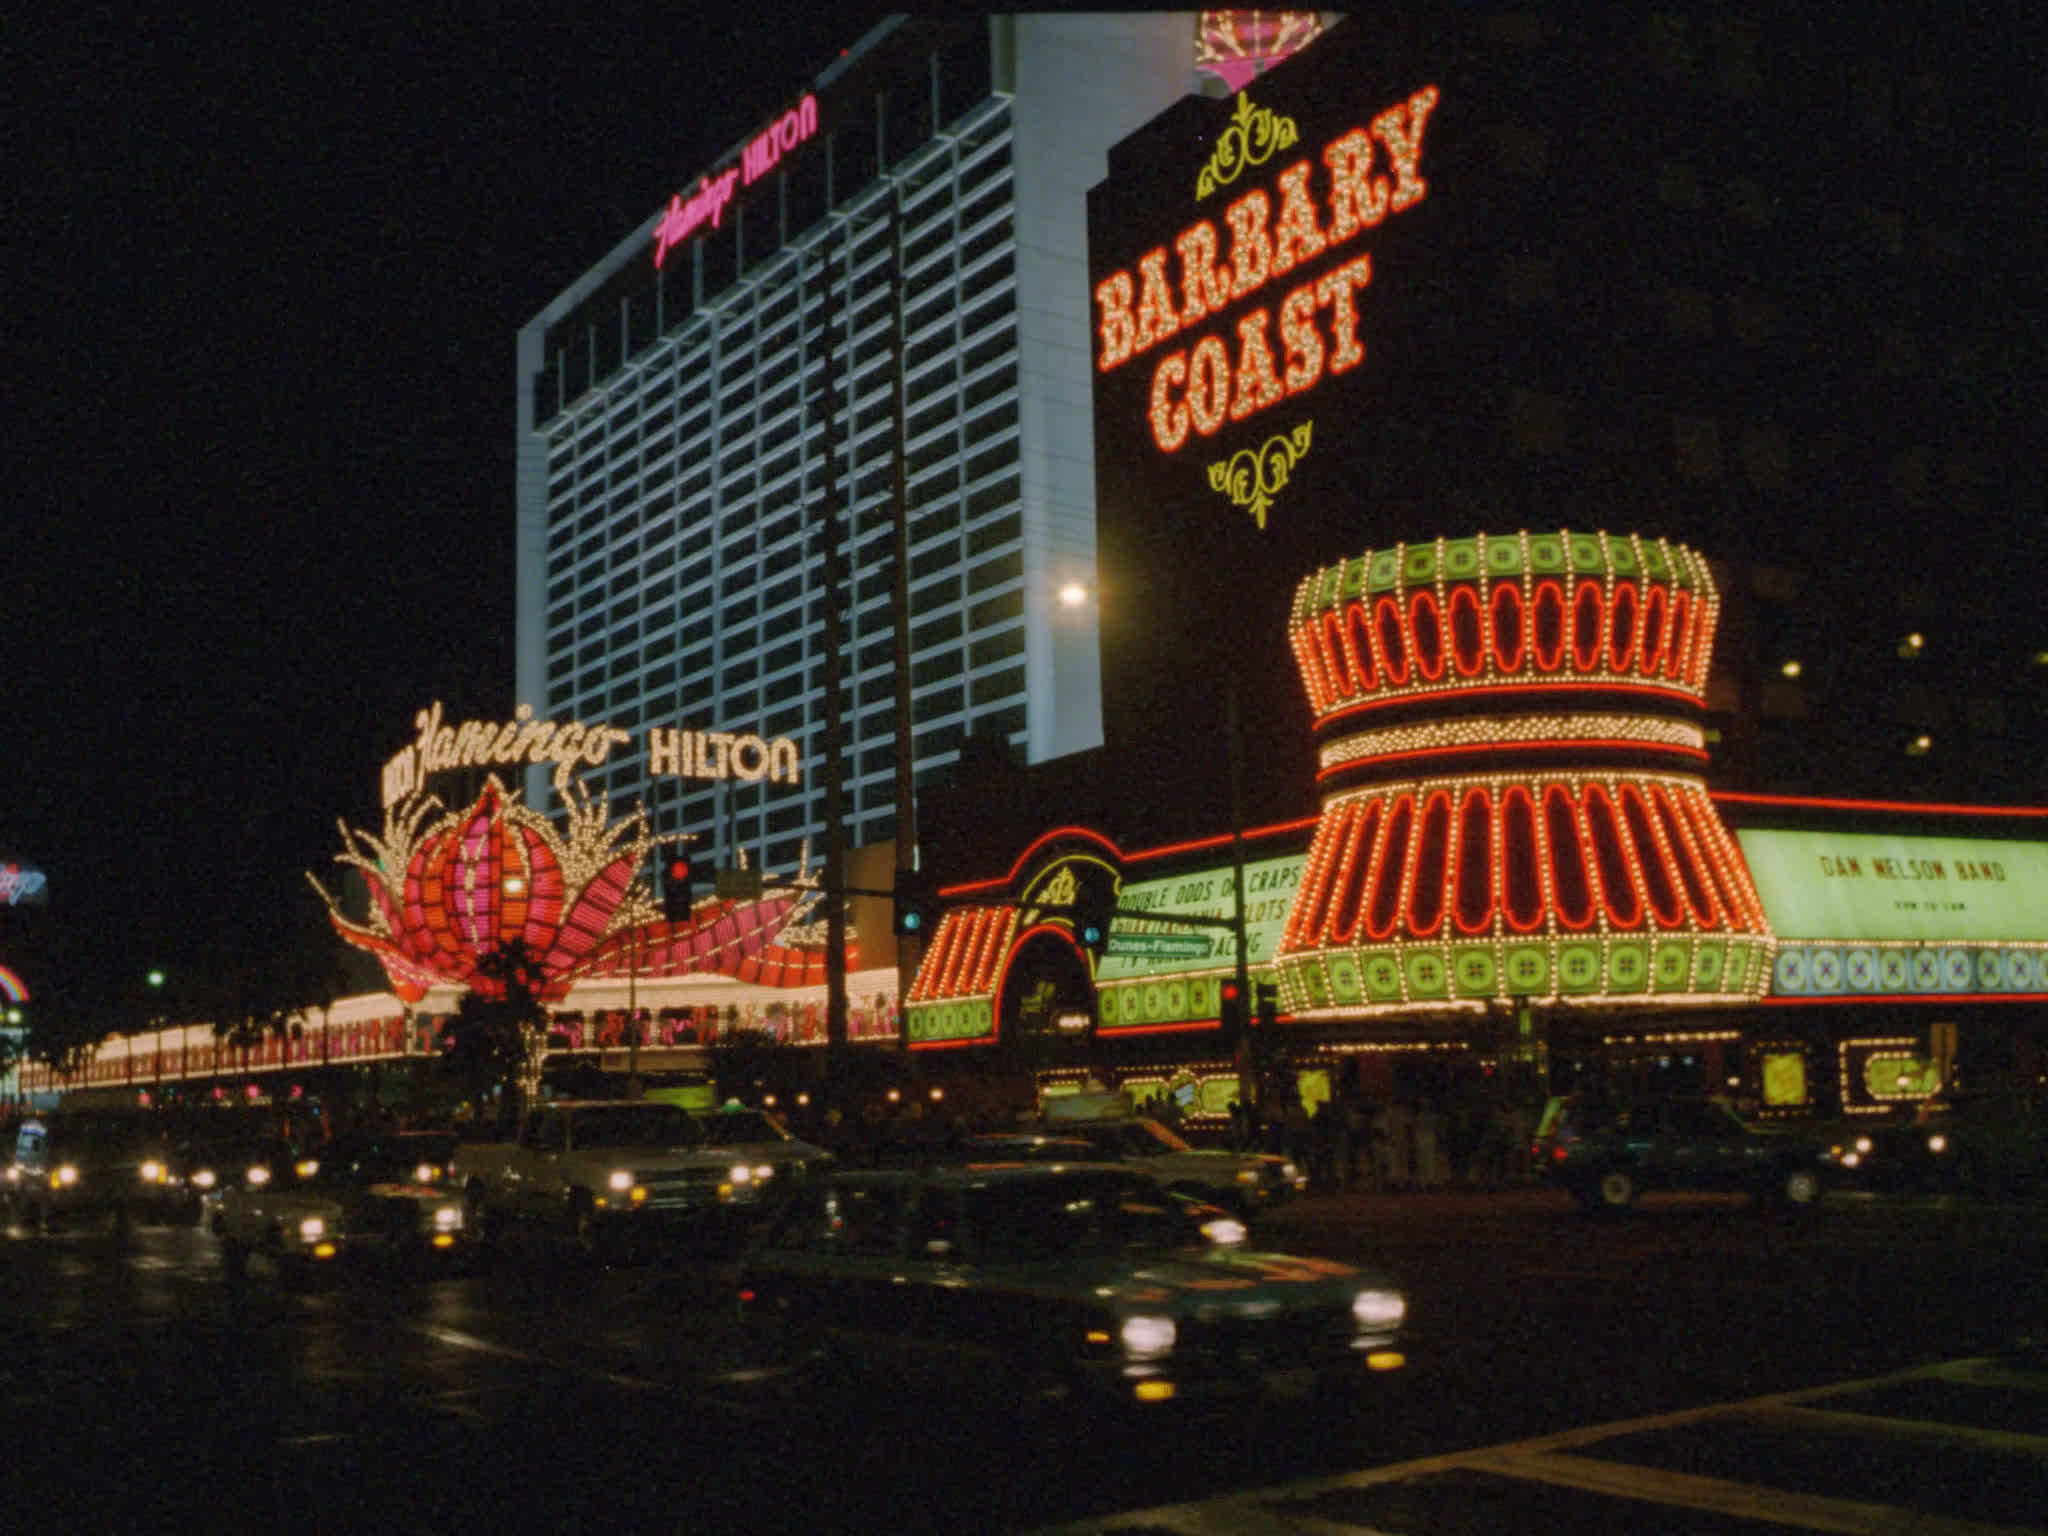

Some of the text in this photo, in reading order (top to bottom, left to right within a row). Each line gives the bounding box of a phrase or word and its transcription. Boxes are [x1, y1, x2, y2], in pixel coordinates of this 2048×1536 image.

[1096, 84, 1440, 373] BARBARY
[1147, 252, 1373, 453] COAST
[415, 699, 630, 791] Flamingo
[648, 727, 800, 784] HILTON
[1119, 887, 1169, 910] DOUBLE
[1175, 880, 1214, 905] ODDS
[1248, 865, 1300, 893] CRAPS
[1819, 855, 2007, 882] DAN NELSON BAND
[1244, 898, 1287, 923] LOTS
